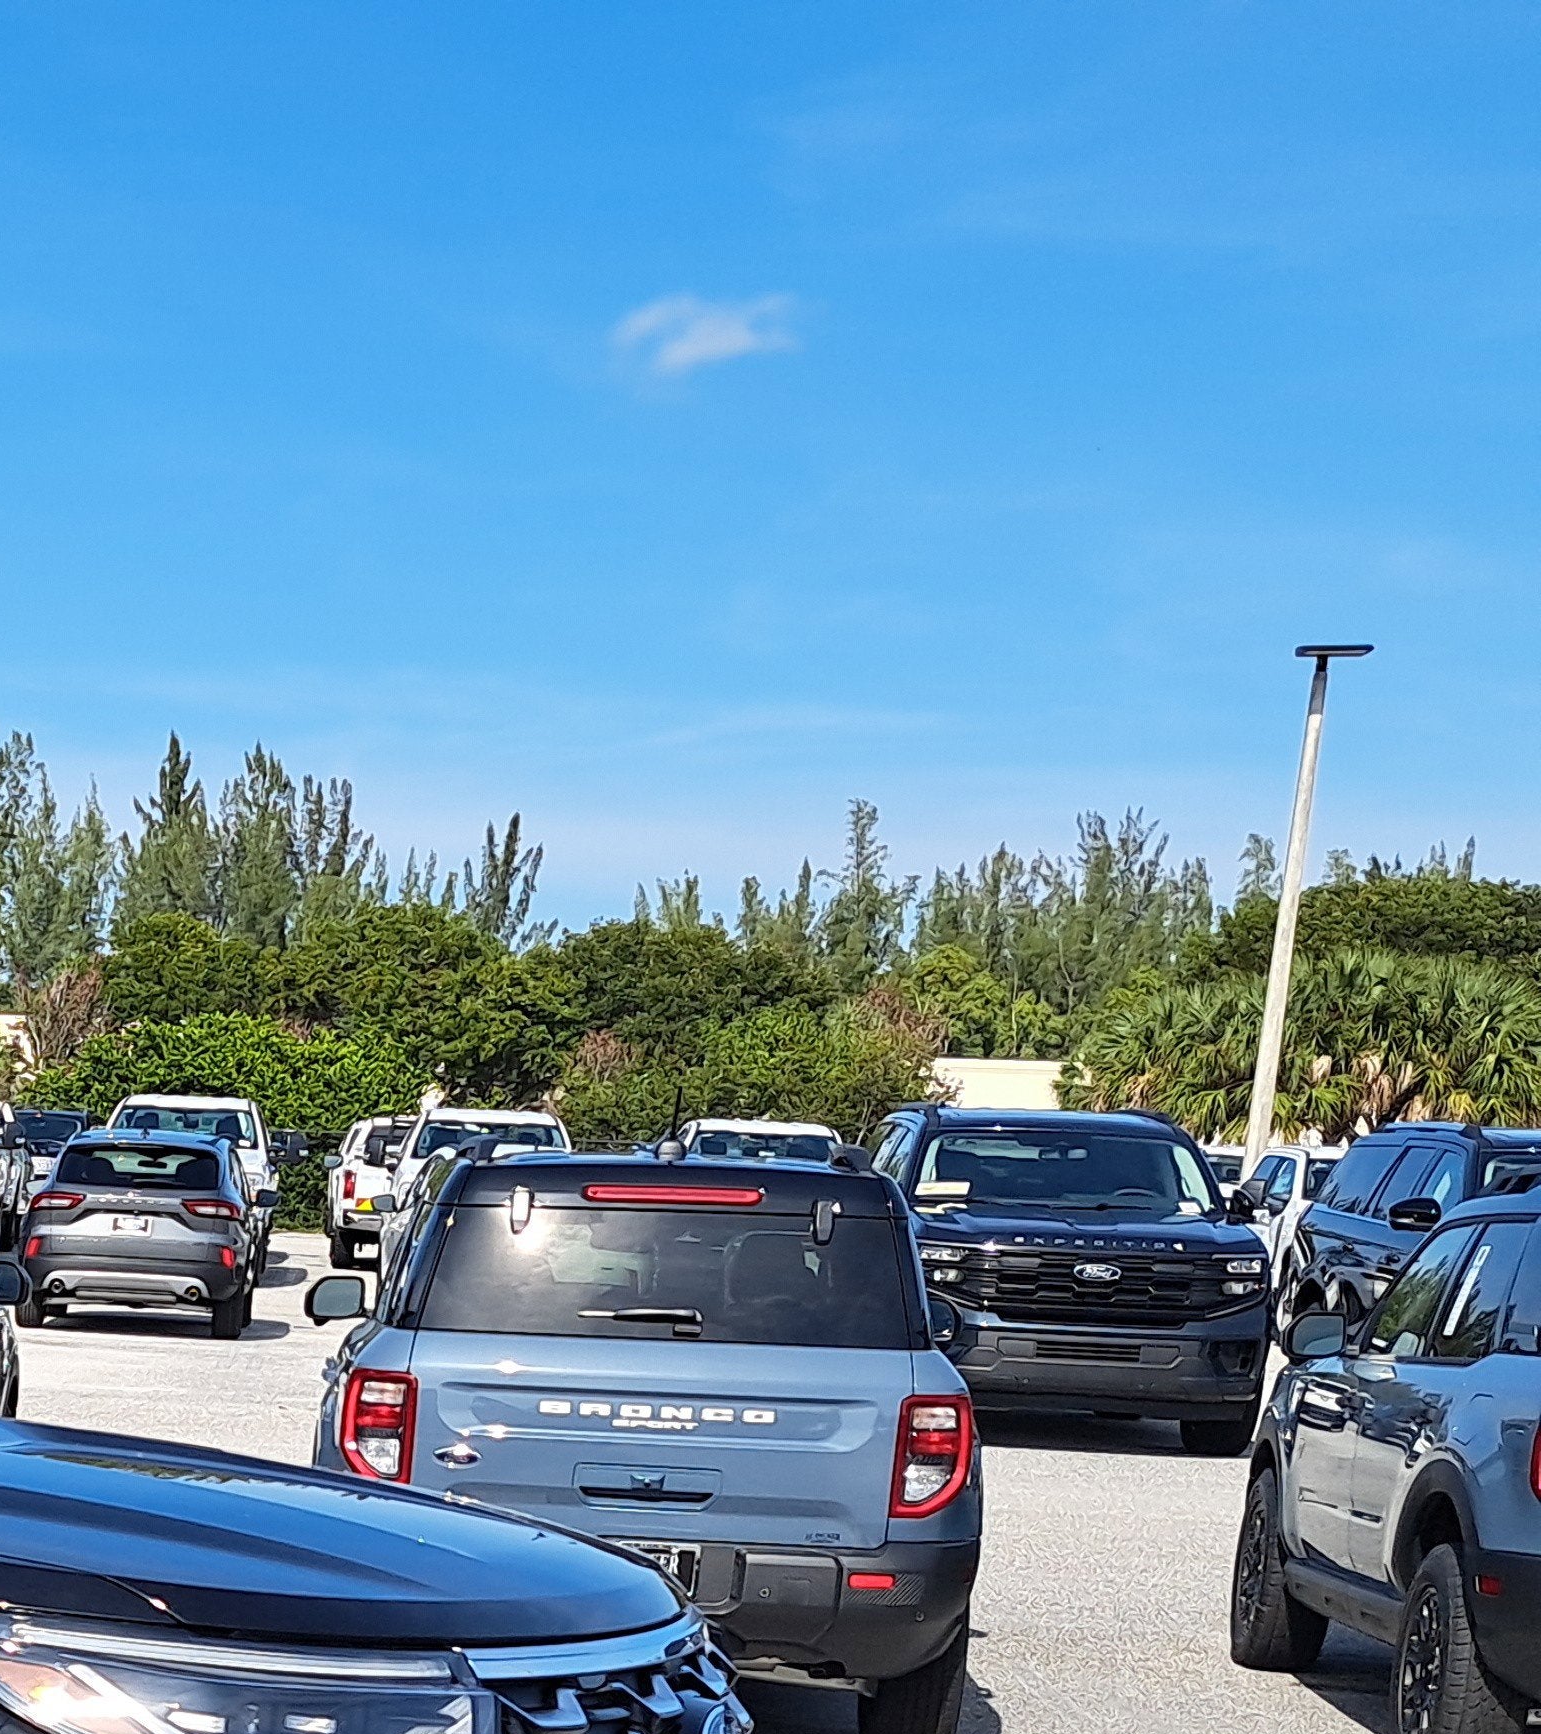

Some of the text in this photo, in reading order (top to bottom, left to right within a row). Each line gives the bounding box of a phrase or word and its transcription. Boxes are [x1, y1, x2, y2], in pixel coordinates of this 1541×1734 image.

[1080, 1264, 1115, 1280] Ford
[537, 1400, 777, 1424] BRONCO
[611, 1418, 699, 1431] SPORT
